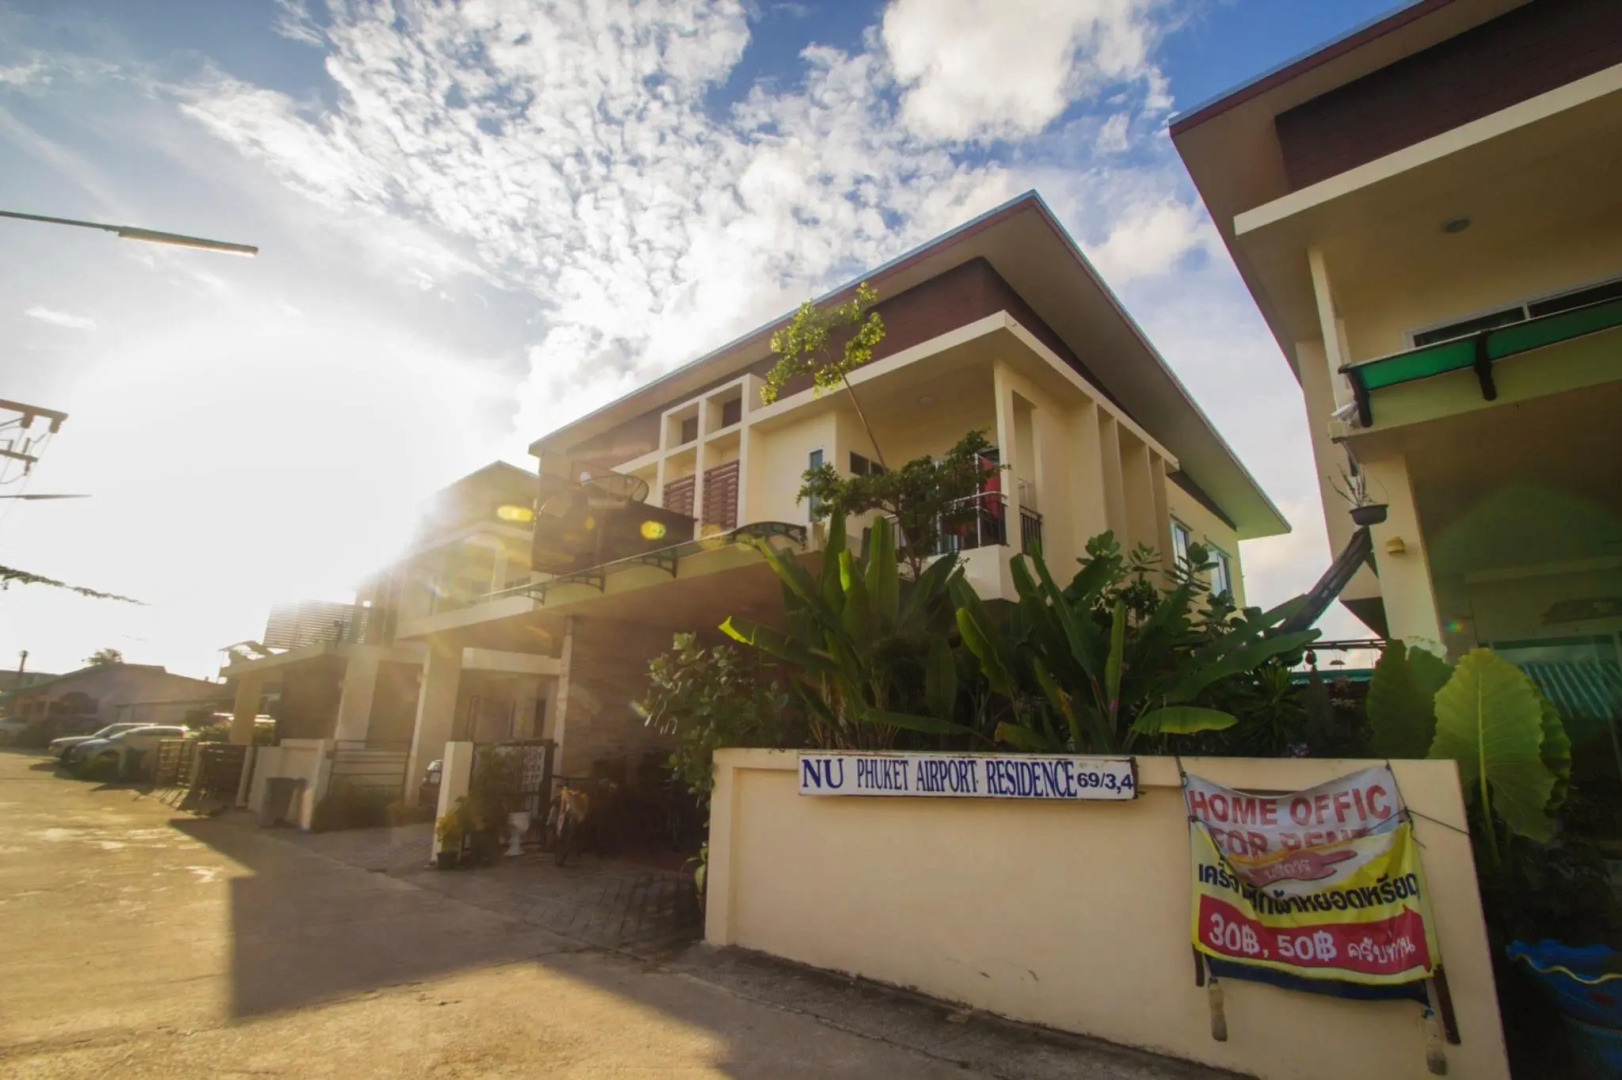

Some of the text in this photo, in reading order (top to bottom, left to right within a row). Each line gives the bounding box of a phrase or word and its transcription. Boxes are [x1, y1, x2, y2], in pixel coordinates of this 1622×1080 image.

[801, 758, 1134, 798] NU PHUKET AIRPORT RESIDENCE 69/3,4
[1187, 784, 1391, 827] HOME OFFIC
